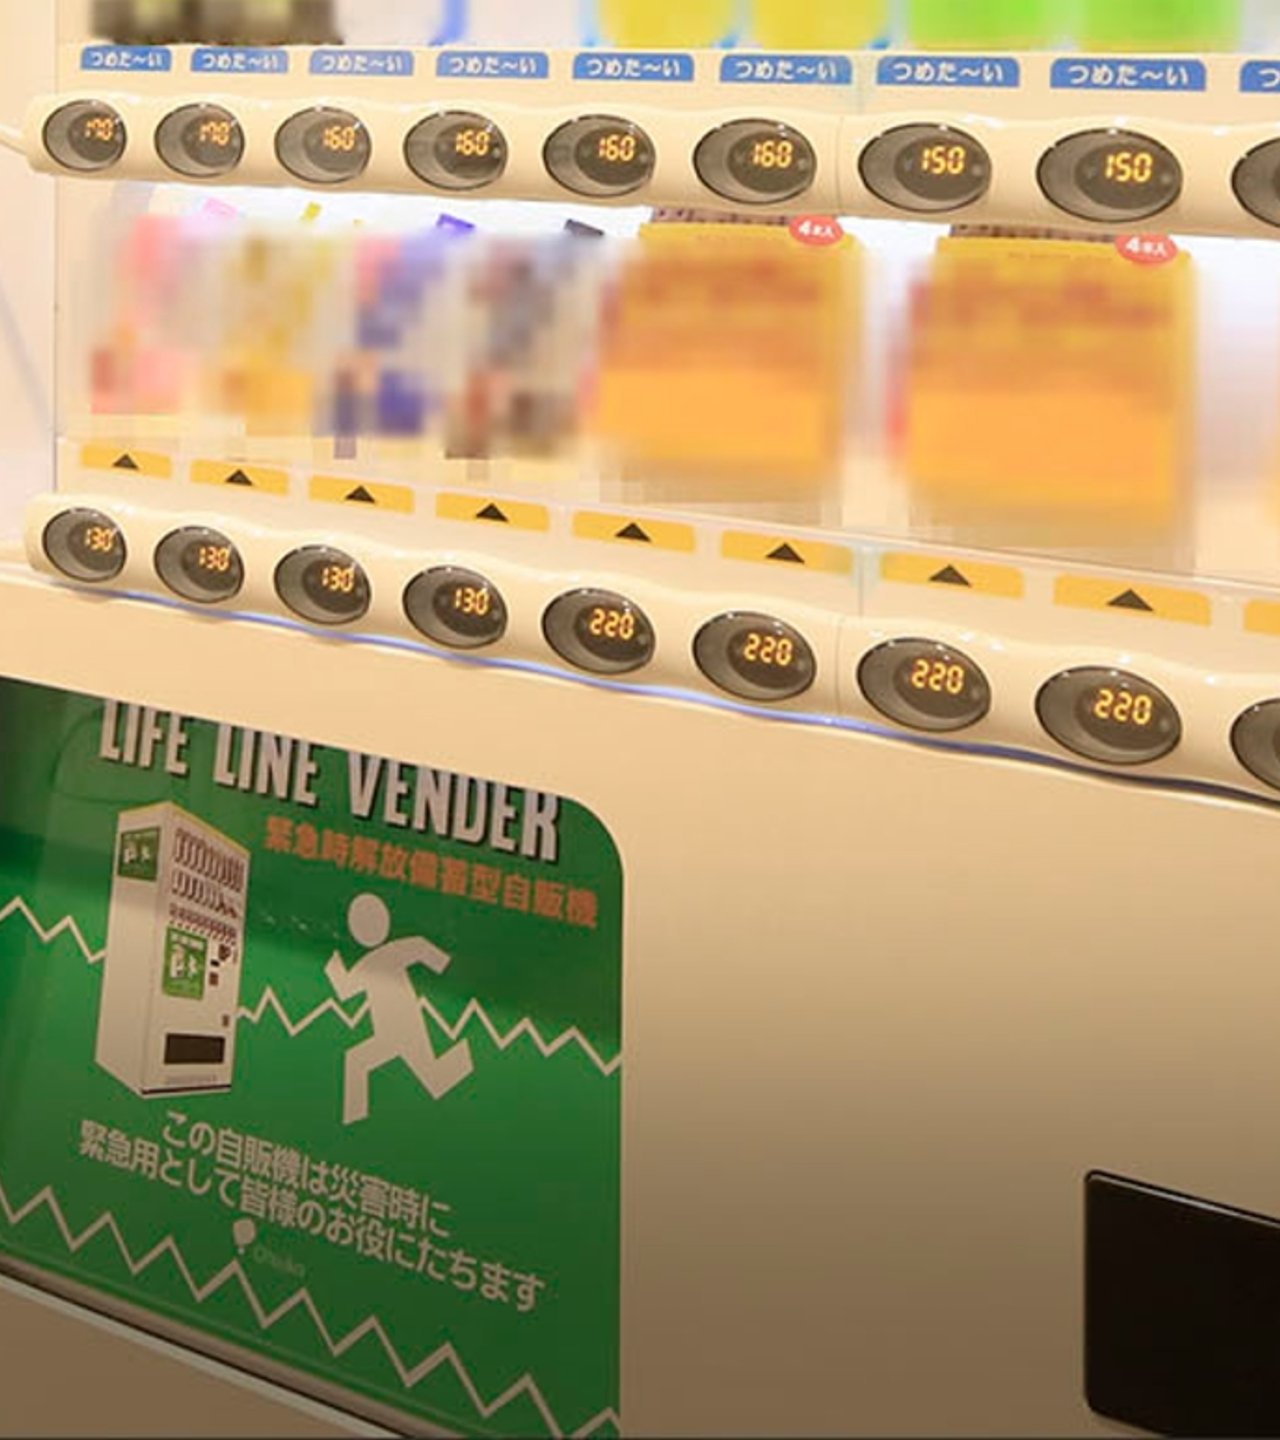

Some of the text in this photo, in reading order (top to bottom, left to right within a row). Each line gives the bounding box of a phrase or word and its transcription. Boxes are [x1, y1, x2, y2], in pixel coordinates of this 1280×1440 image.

[455, 129, 490, 156] 160
[598, 134, 636, 161] 160
[752, 140, 793, 168] 160
[920, 146, 965, 176] 150
[1104, 151, 1153, 183] 150
[198, 546, 231, 573] 130
[321, 566, 355, 593] 130
[453, 586, 490, 616] 130
[589, 608, 635, 640] 220
[743, 633, 793, 667] 220
[911, 659, 965, 695] 220
[1093, 688, 1152, 726] 220
[98, 698, 560, 862] LIFE LINE VENDER
[162, 1111, 451, 1237] この自販機は災害時に
[79, 1119, 546, 1311] 緊急用として皆様のお役にたちます
